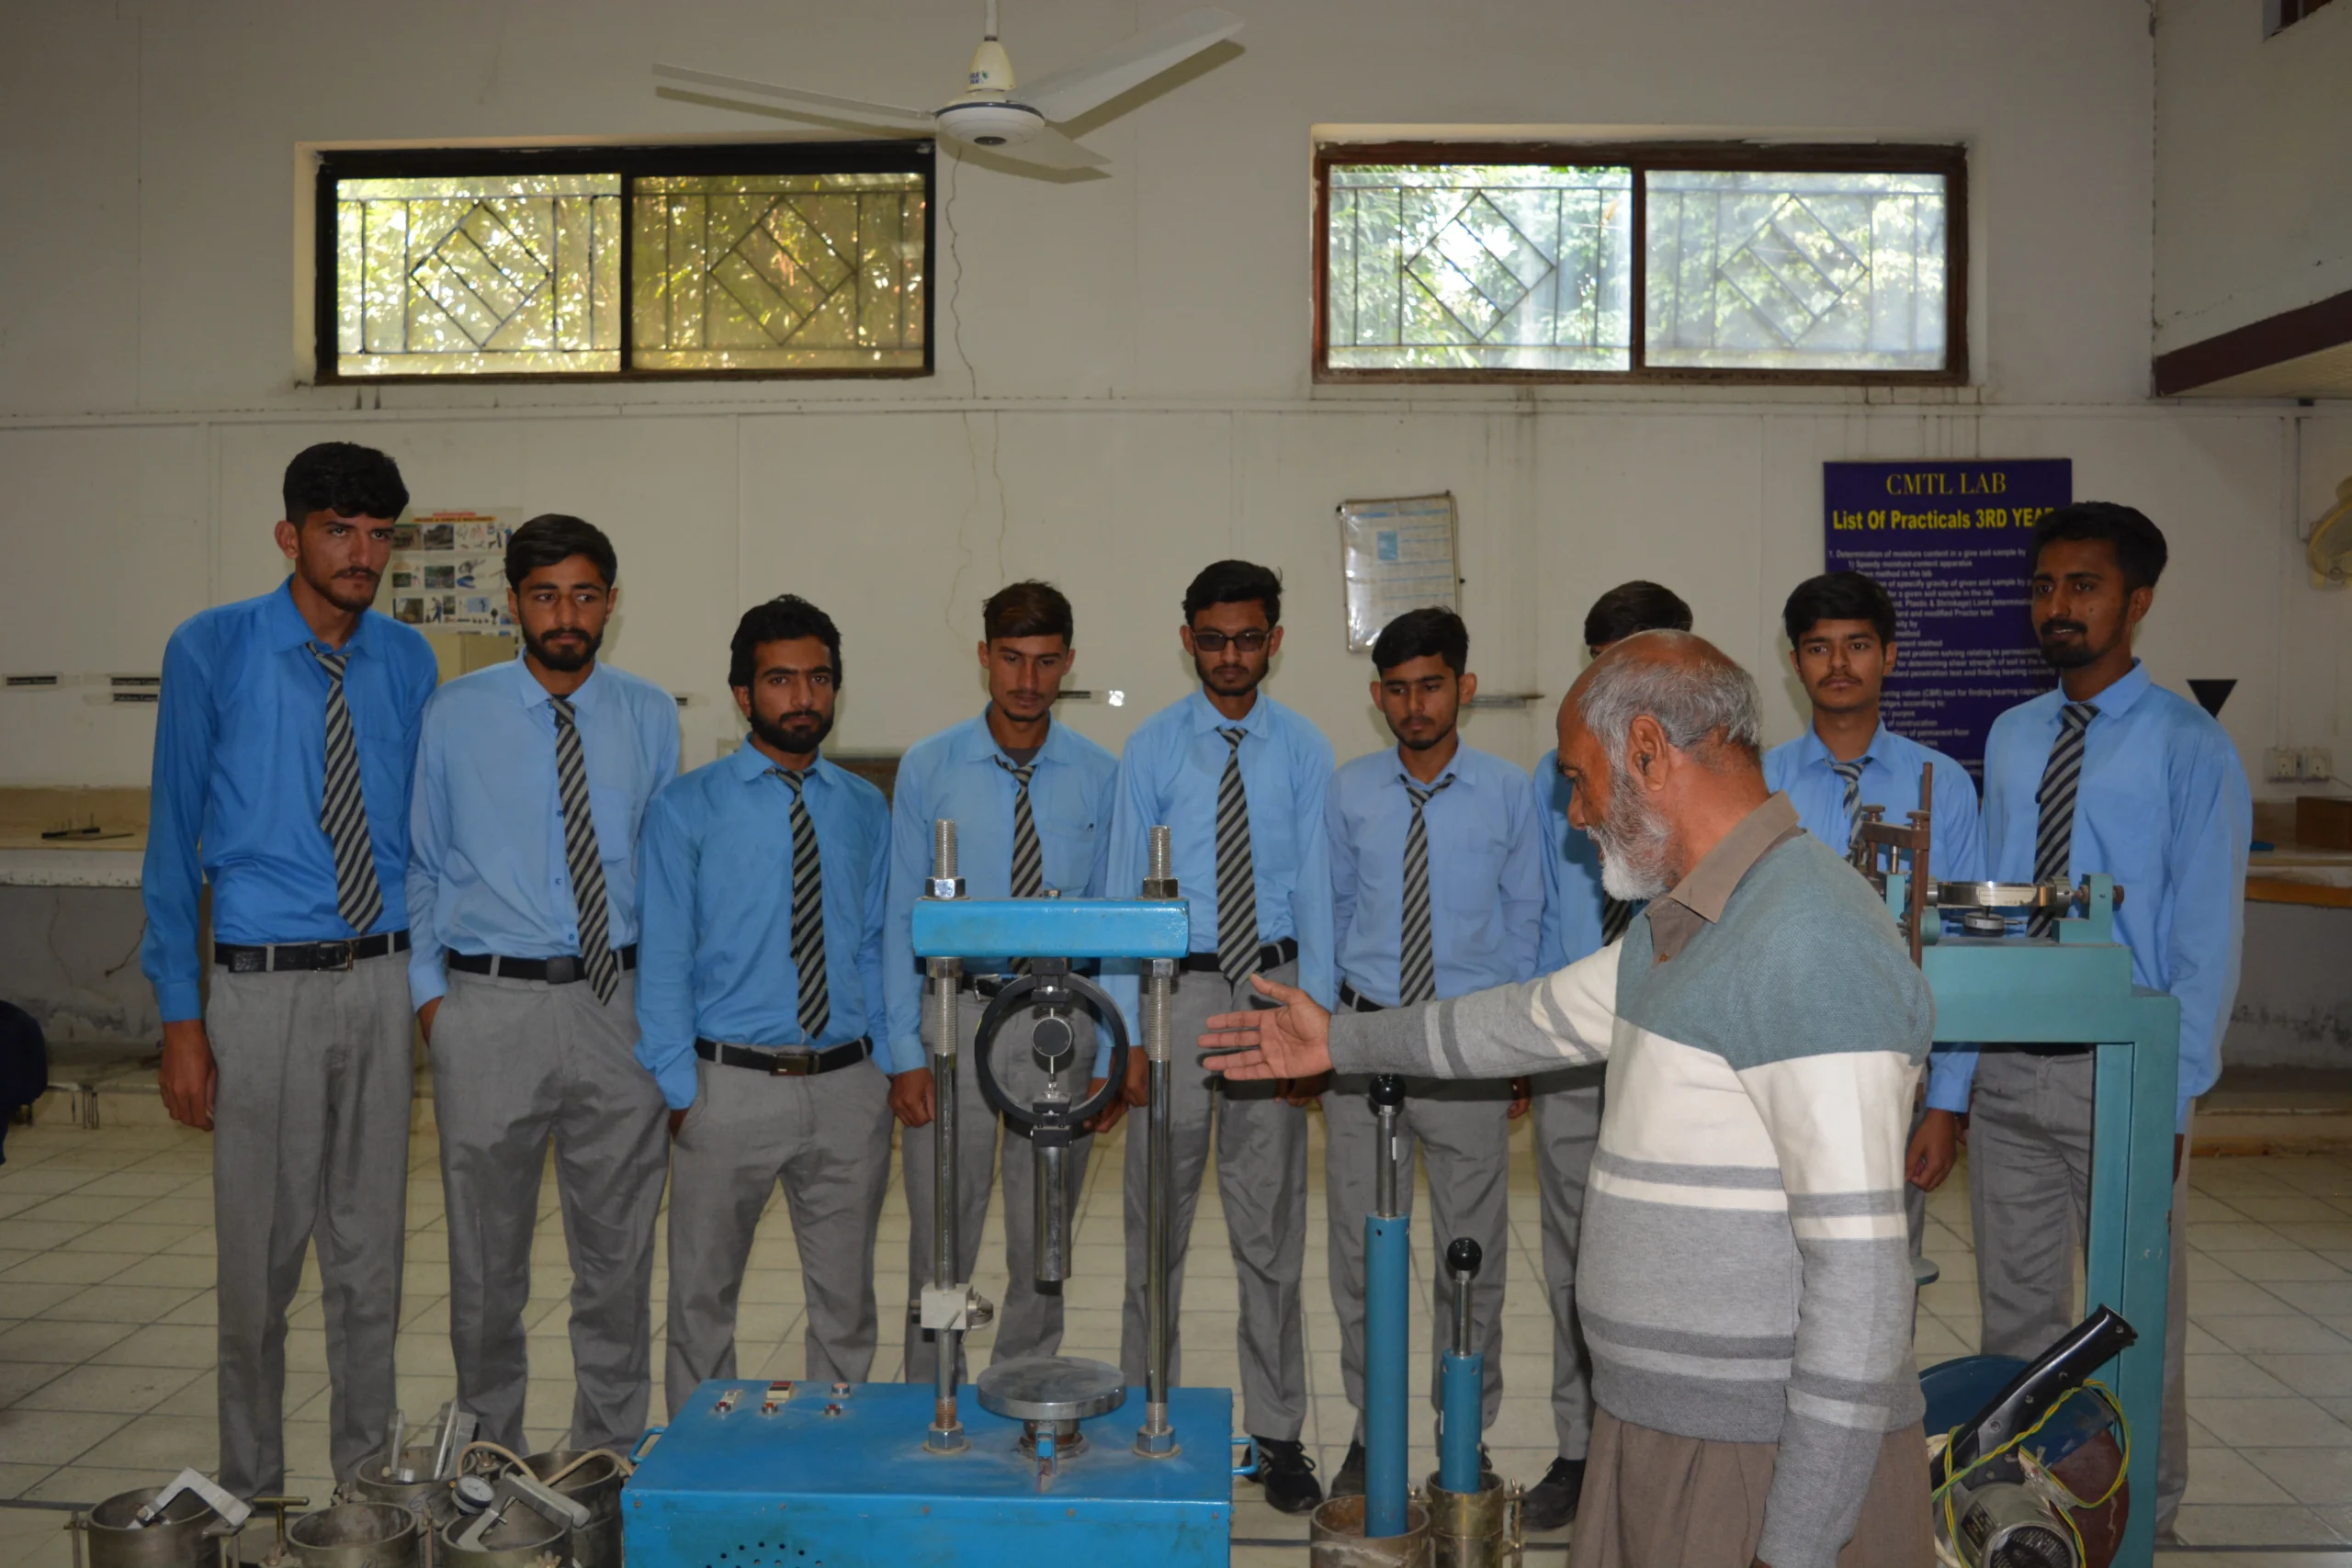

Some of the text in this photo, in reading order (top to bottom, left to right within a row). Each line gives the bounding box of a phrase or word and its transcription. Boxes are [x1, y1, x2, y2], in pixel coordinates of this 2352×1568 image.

[1886, 472, 2007, 495] CMTL LAB
[1833, 510, 1863, 530] List
[1867, 509, 1886, 530] Of
[1891, 508, 1971, 530] Practicals
[1976, 508, 2007, 528] 3RD
[1836, 549, 1883, 558] Determination
[1884, 549, 1892, 558] of
[1893, 549, 1922, 558] moisture
[1923, 549, 1949, 558] content
[1992, 548, 2017, 558] sample
[2018, 547, 2027, 558] by
[1913, 559, 1939, 568] content
[1909, 570, 1921, 578] the
